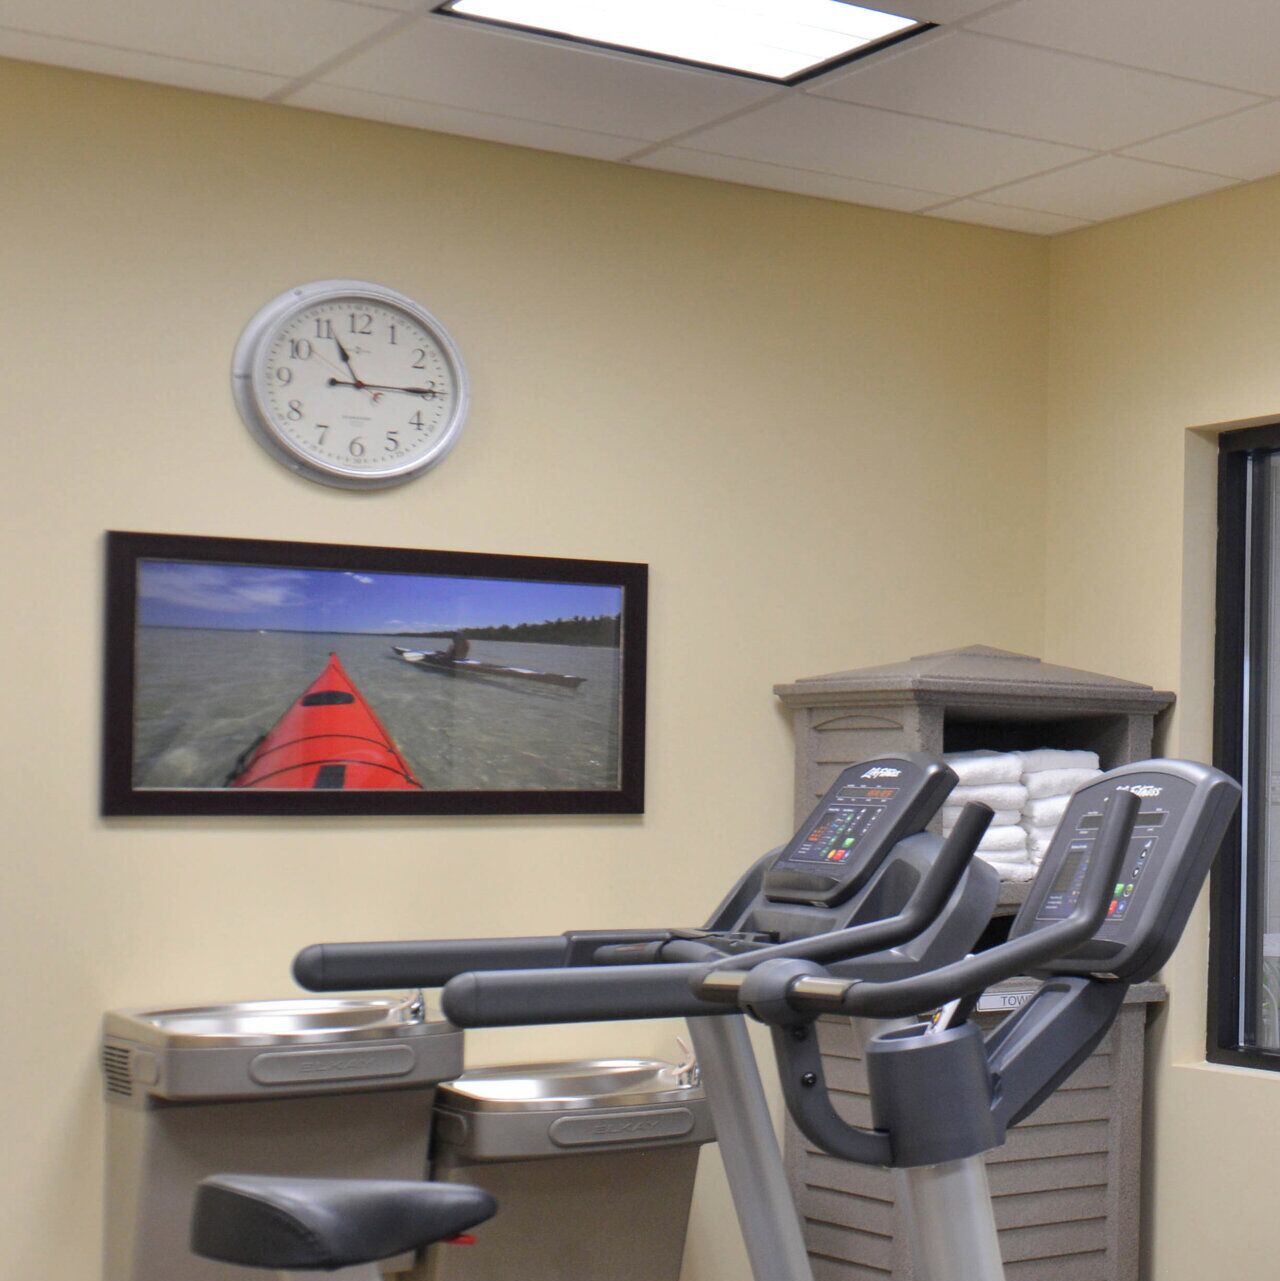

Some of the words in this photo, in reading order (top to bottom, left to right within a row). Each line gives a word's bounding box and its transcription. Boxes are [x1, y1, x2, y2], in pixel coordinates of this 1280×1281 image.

[314, 317, 333, 340] 11
[348, 312, 374, 335] 12
[387, 324, 398, 346] 1
[288, 338, 313, 361] 10
[410, 347, 426, 370] 2
[275, 366, 293, 387] 9
[287, 399, 304, 421] 8
[408, 410, 425, 431] 4
[315, 423, 330, 446] 7
[384, 430, 400, 452] 5
[349, 436, 365, 458] 6
